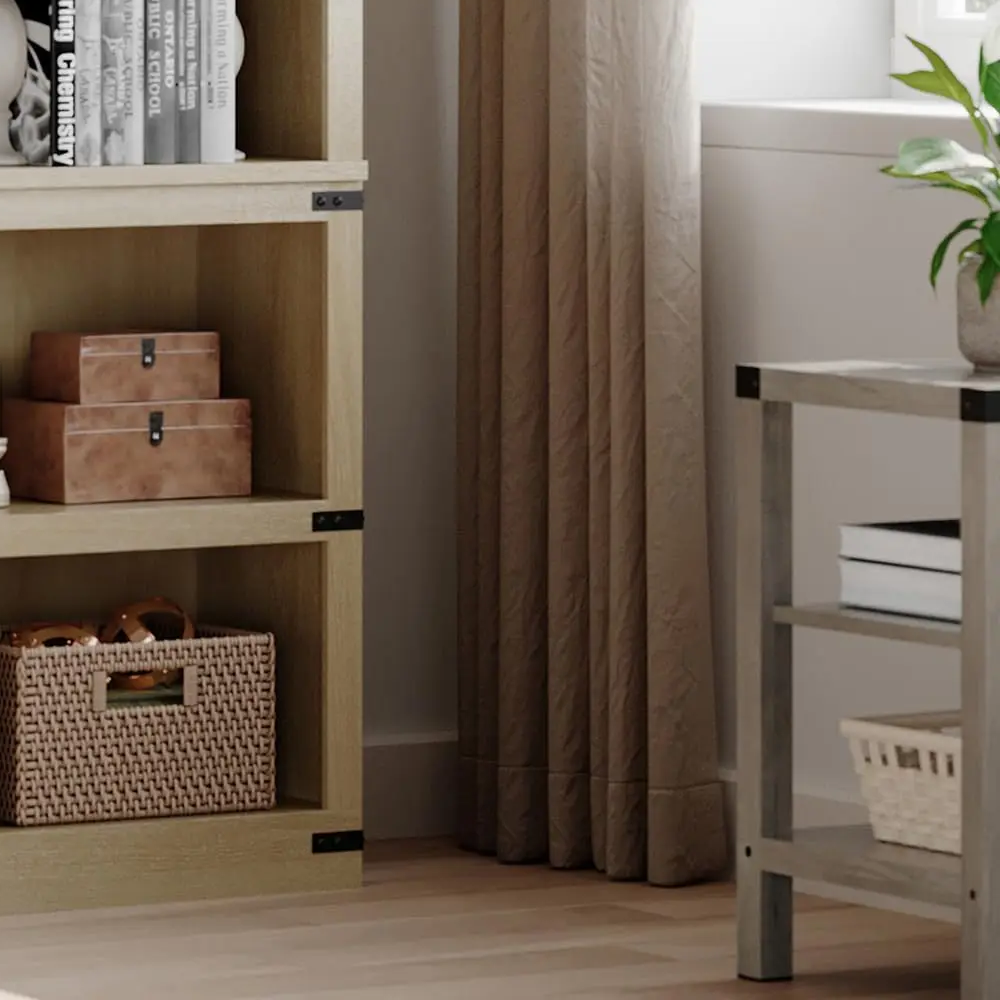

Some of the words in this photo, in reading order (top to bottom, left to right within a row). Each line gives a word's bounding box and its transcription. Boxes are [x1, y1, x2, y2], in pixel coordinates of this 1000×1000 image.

[164, 10, 175, 89] ONTARIO
[52, 52, 76, 166] Chemistry
[148, 51, 161, 119] SCHOOL
[187, 61, 198, 110] Nation
[216, 62, 230, 109] Nation
